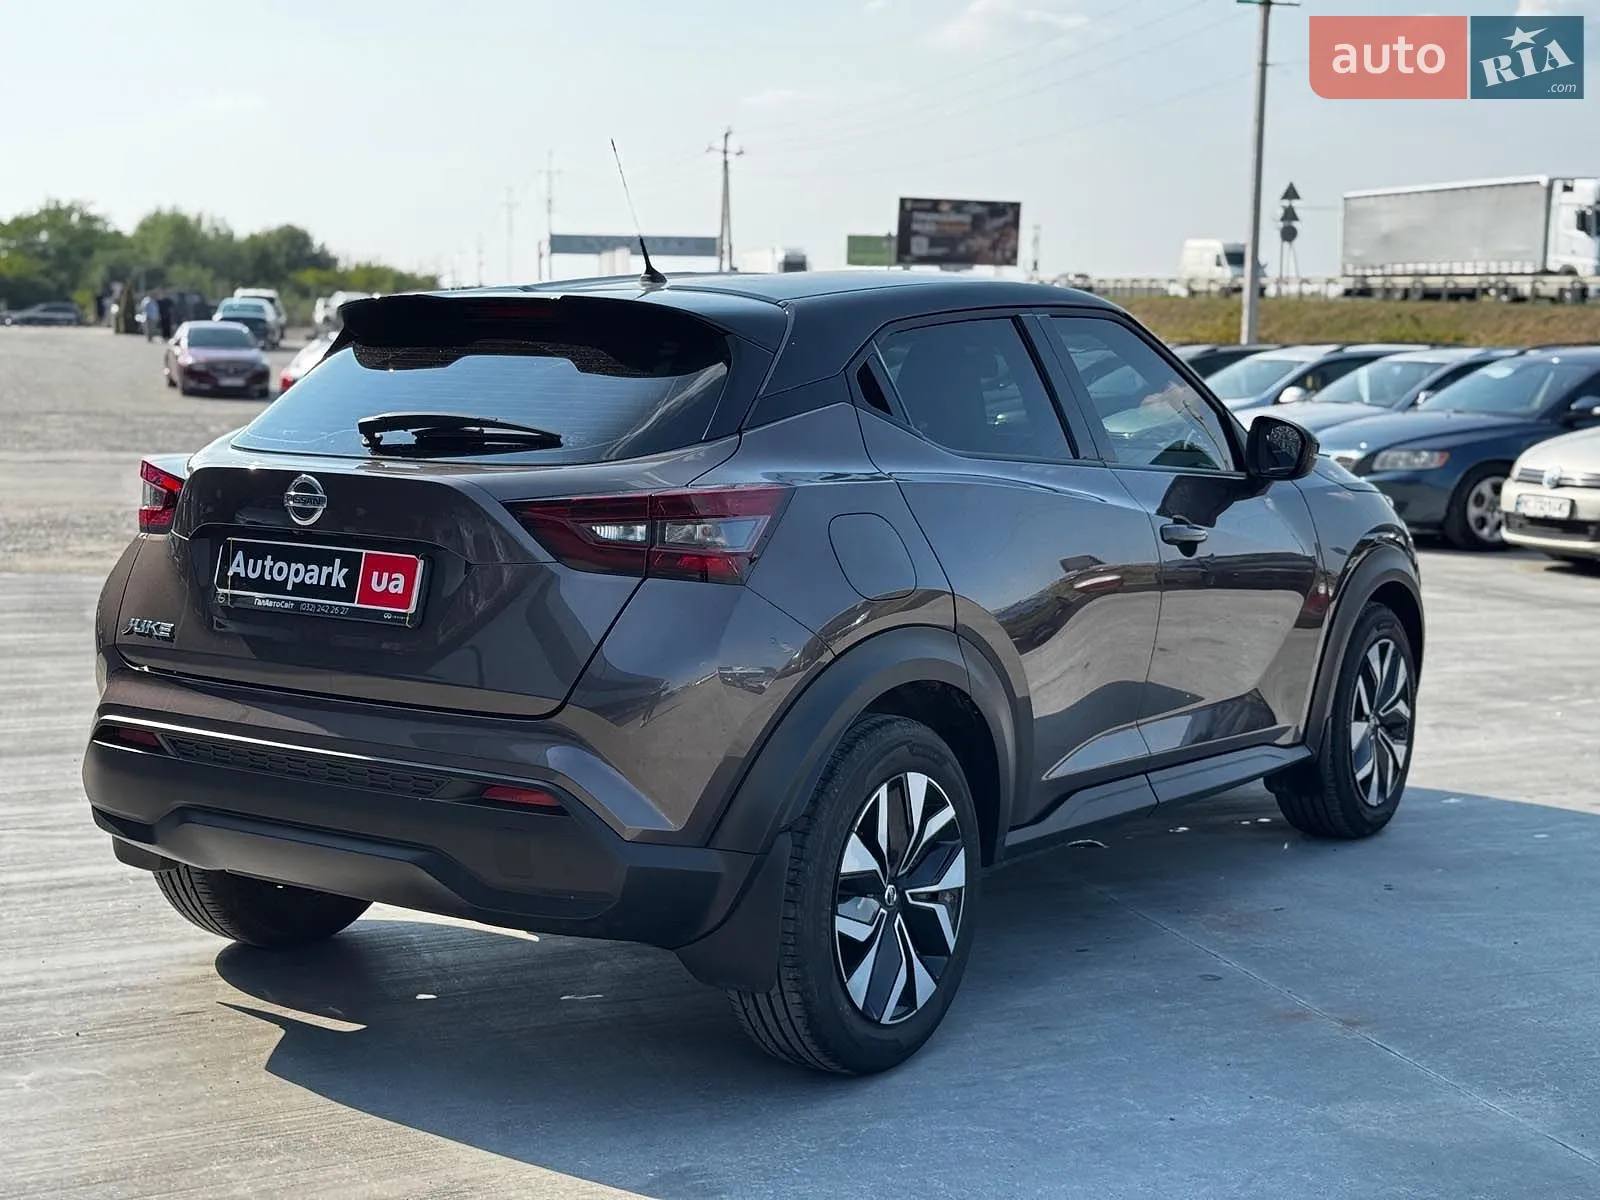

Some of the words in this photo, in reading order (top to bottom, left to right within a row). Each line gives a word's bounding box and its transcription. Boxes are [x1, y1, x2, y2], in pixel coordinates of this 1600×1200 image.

[286, 494, 321, 505] NISSAN
[231, 551, 349, 590] Autopark
[371, 572, 405, 594] ua
[299, 602, 315, 613] (032)
[316, 604, 330, 614] 242
[340, 607, 349, 615] 27
[121, 618, 175, 637] JUKE
